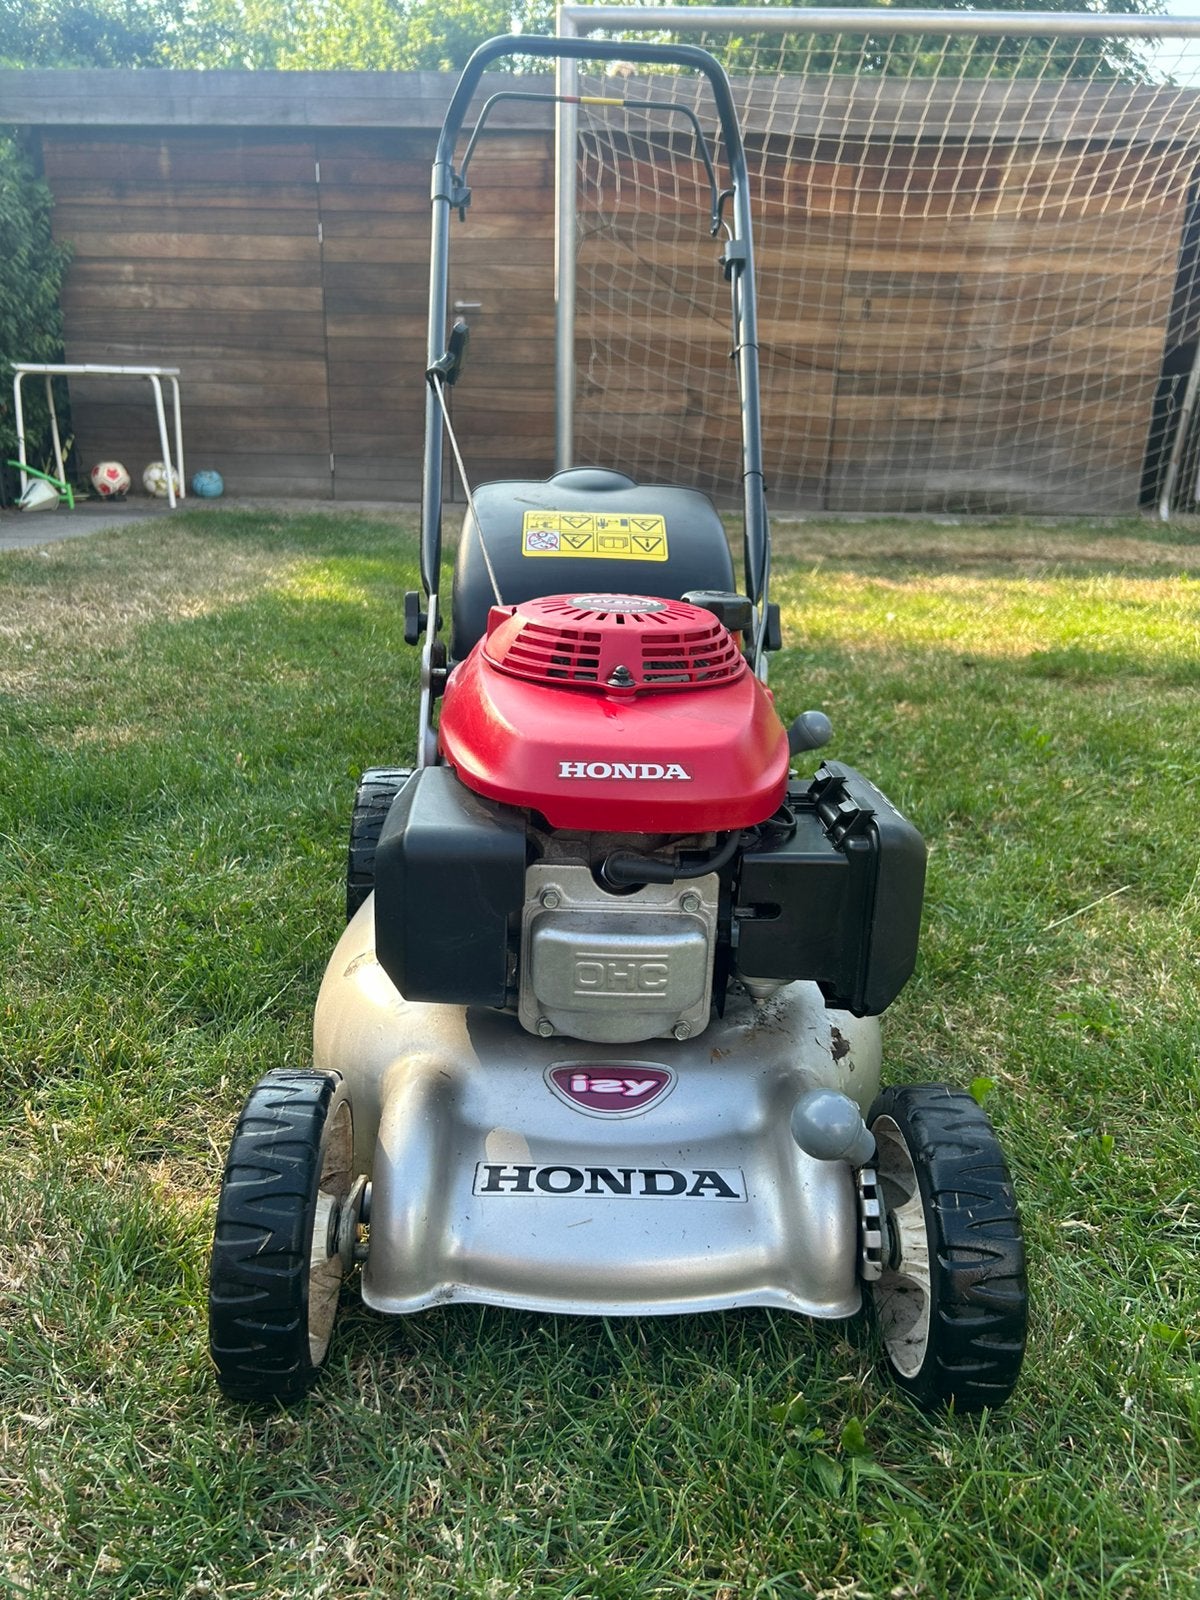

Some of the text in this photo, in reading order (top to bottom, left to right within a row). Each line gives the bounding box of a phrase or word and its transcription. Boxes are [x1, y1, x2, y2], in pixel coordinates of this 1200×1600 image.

[558, 761, 692, 780] HONDA
[575, 961, 668, 990] OHC
[570, 1073, 660, 1097] izy
[481, 1165, 741, 1199] HONDA
